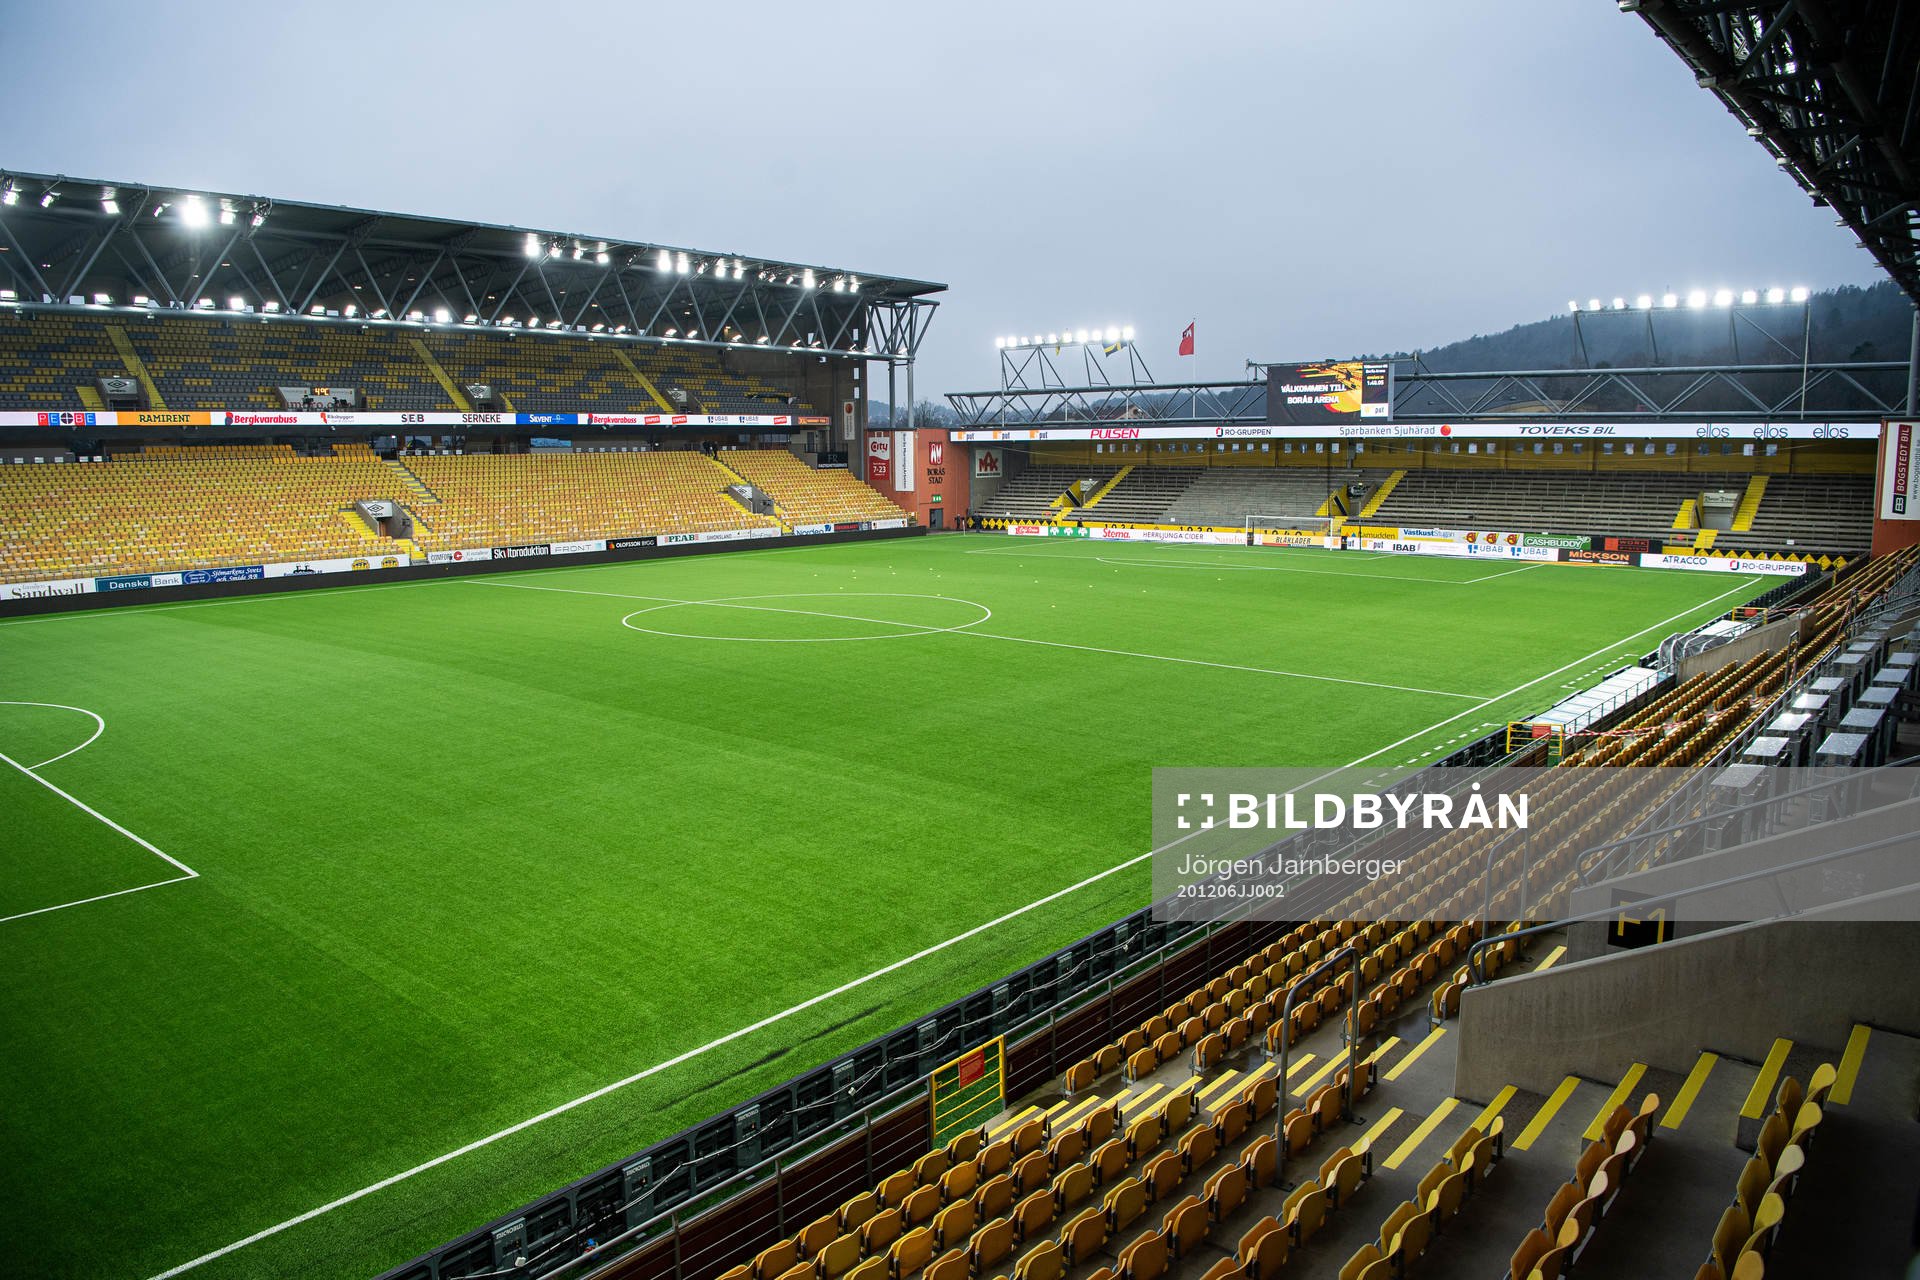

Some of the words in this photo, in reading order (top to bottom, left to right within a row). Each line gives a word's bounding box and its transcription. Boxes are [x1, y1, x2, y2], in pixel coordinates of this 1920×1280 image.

[1280, 383, 1329, 393] VÄLKOMMEN
[1330, 383, 1346, 392] TILL
[1287, 394, 1313, 404] BORÅS
[1314, 395, 1340, 404] ARENA
[139, 414, 190, 423] RAMIRENT
[234, 414, 298, 425] Bergkvarabuss
[401, 413, 425, 423] SEB
[462, 413, 501, 423] SERNEKE
[593, 416, 637, 425] Bergkvarabuss
[1090, 428, 1140, 439] PULSEN
[1224, 428, 1272, 437] RO-GRUPPEN
[1339, 426, 1392, 437] Sparbanken
[1394, 425, 1435, 437] Sjuhärad
[1519, 426, 1590, 435] TOVEKS
[1593, 426, 1616, 435] BIL
[1696, 423, 1730, 438] ellos
[1753, 423, 1789, 438] ellos
[1812, 423, 1849, 438] ellos
[1900, 427, 1910, 442] BIL
[927, 467, 945, 476] BORÅS
[1896, 443, 1908, 492] BOGSTEDT
[928, 476, 943, 484] STAD
[669, 534, 695, 543] PEAB
[1142, 531, 1184, 540] HERRLJUNGA
[1185, 532, 1204, 540] CIDER
[1392, 543, 1416, 552] IBAB
[1526, 538, 1582, 549] CASHBUDDY
[1479, 545, 1504, 553] UBAB
[1523, 547, 1548, 555] UBAB
[1662, 555, 1708, 566] ATRACCO
[1741, 562, 1804, 573] RO-GRUPPEN
[109, 580, 149, 590] Danske
[154, 577, 180, 586] Bank
[11, 582, 85, 599] Sandwall
